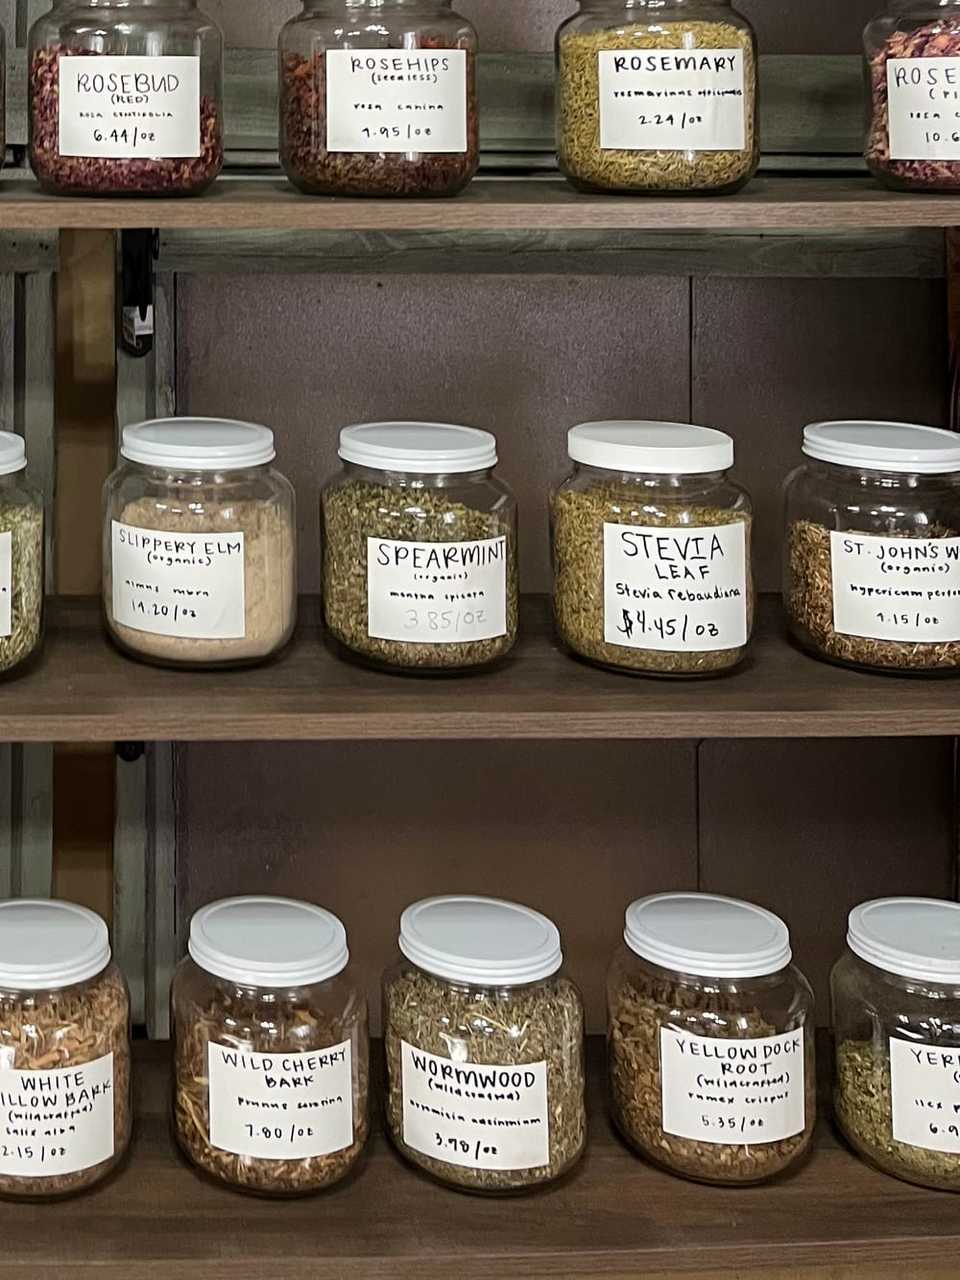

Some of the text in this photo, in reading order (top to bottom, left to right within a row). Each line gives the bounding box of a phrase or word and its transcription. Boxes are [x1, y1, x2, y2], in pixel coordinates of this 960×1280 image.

[350, 55, 449, 73] ROSEHIPS
[613, 54, 737, 74] ROSEMARY
[77, 72, 180, 95] ROSEBUD
[110, 92, 149, 106] (RED)
[119, 527, 241, 556] SLIPPERY ELM
[620, 531, 725, 562] STEVIA
[875, 541, 940, 561] JOHN'S
[376, 540, 504, 570] SPEARMINT
[653, 562, 711, 581] LEAF
[615, 582, 663, 600] Stevia
[675, 1037, 801, 1061] YELLOW DOCK
[221, 1047, 346, 1074] WILD CHERRY
[720, 1061, 773, 1076] ROOT
[20, 1070, 85, 1090] WHITE
[410, 1052, 535, 1090] WORMWOOD
[264, 1074, 315, 1089] BARK
[66, 1080, 112, 1108] BARK
